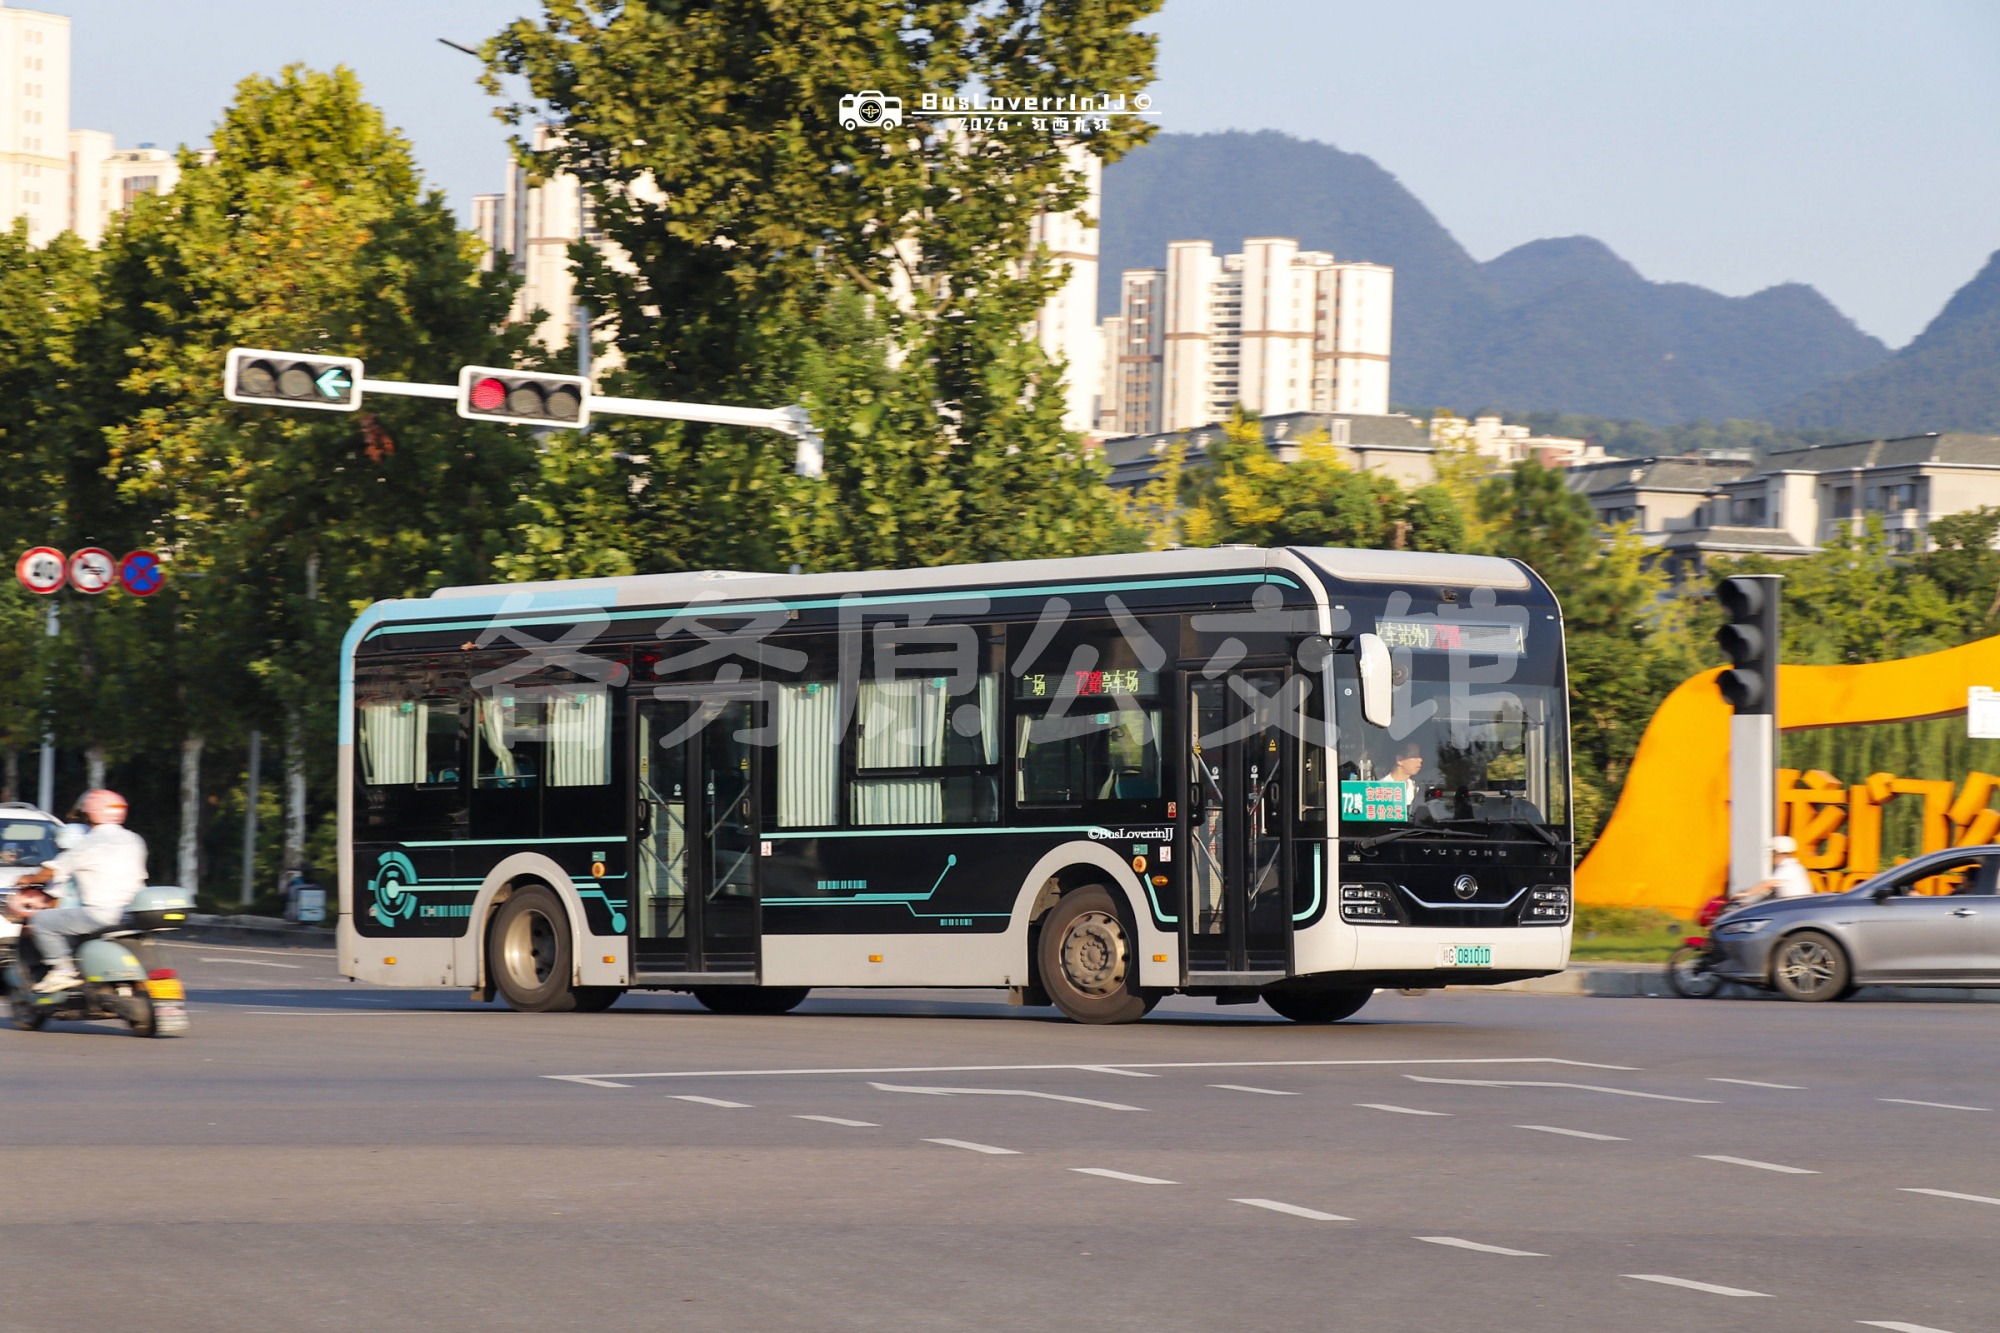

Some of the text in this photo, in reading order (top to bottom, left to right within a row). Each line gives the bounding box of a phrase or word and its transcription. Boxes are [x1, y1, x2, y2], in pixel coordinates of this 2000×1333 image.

[1075, 670, 1103, 696] 72路
[1366, 804, 1403, 820] 票价2元
[1423, 848, 1507, 857] YUTONG
